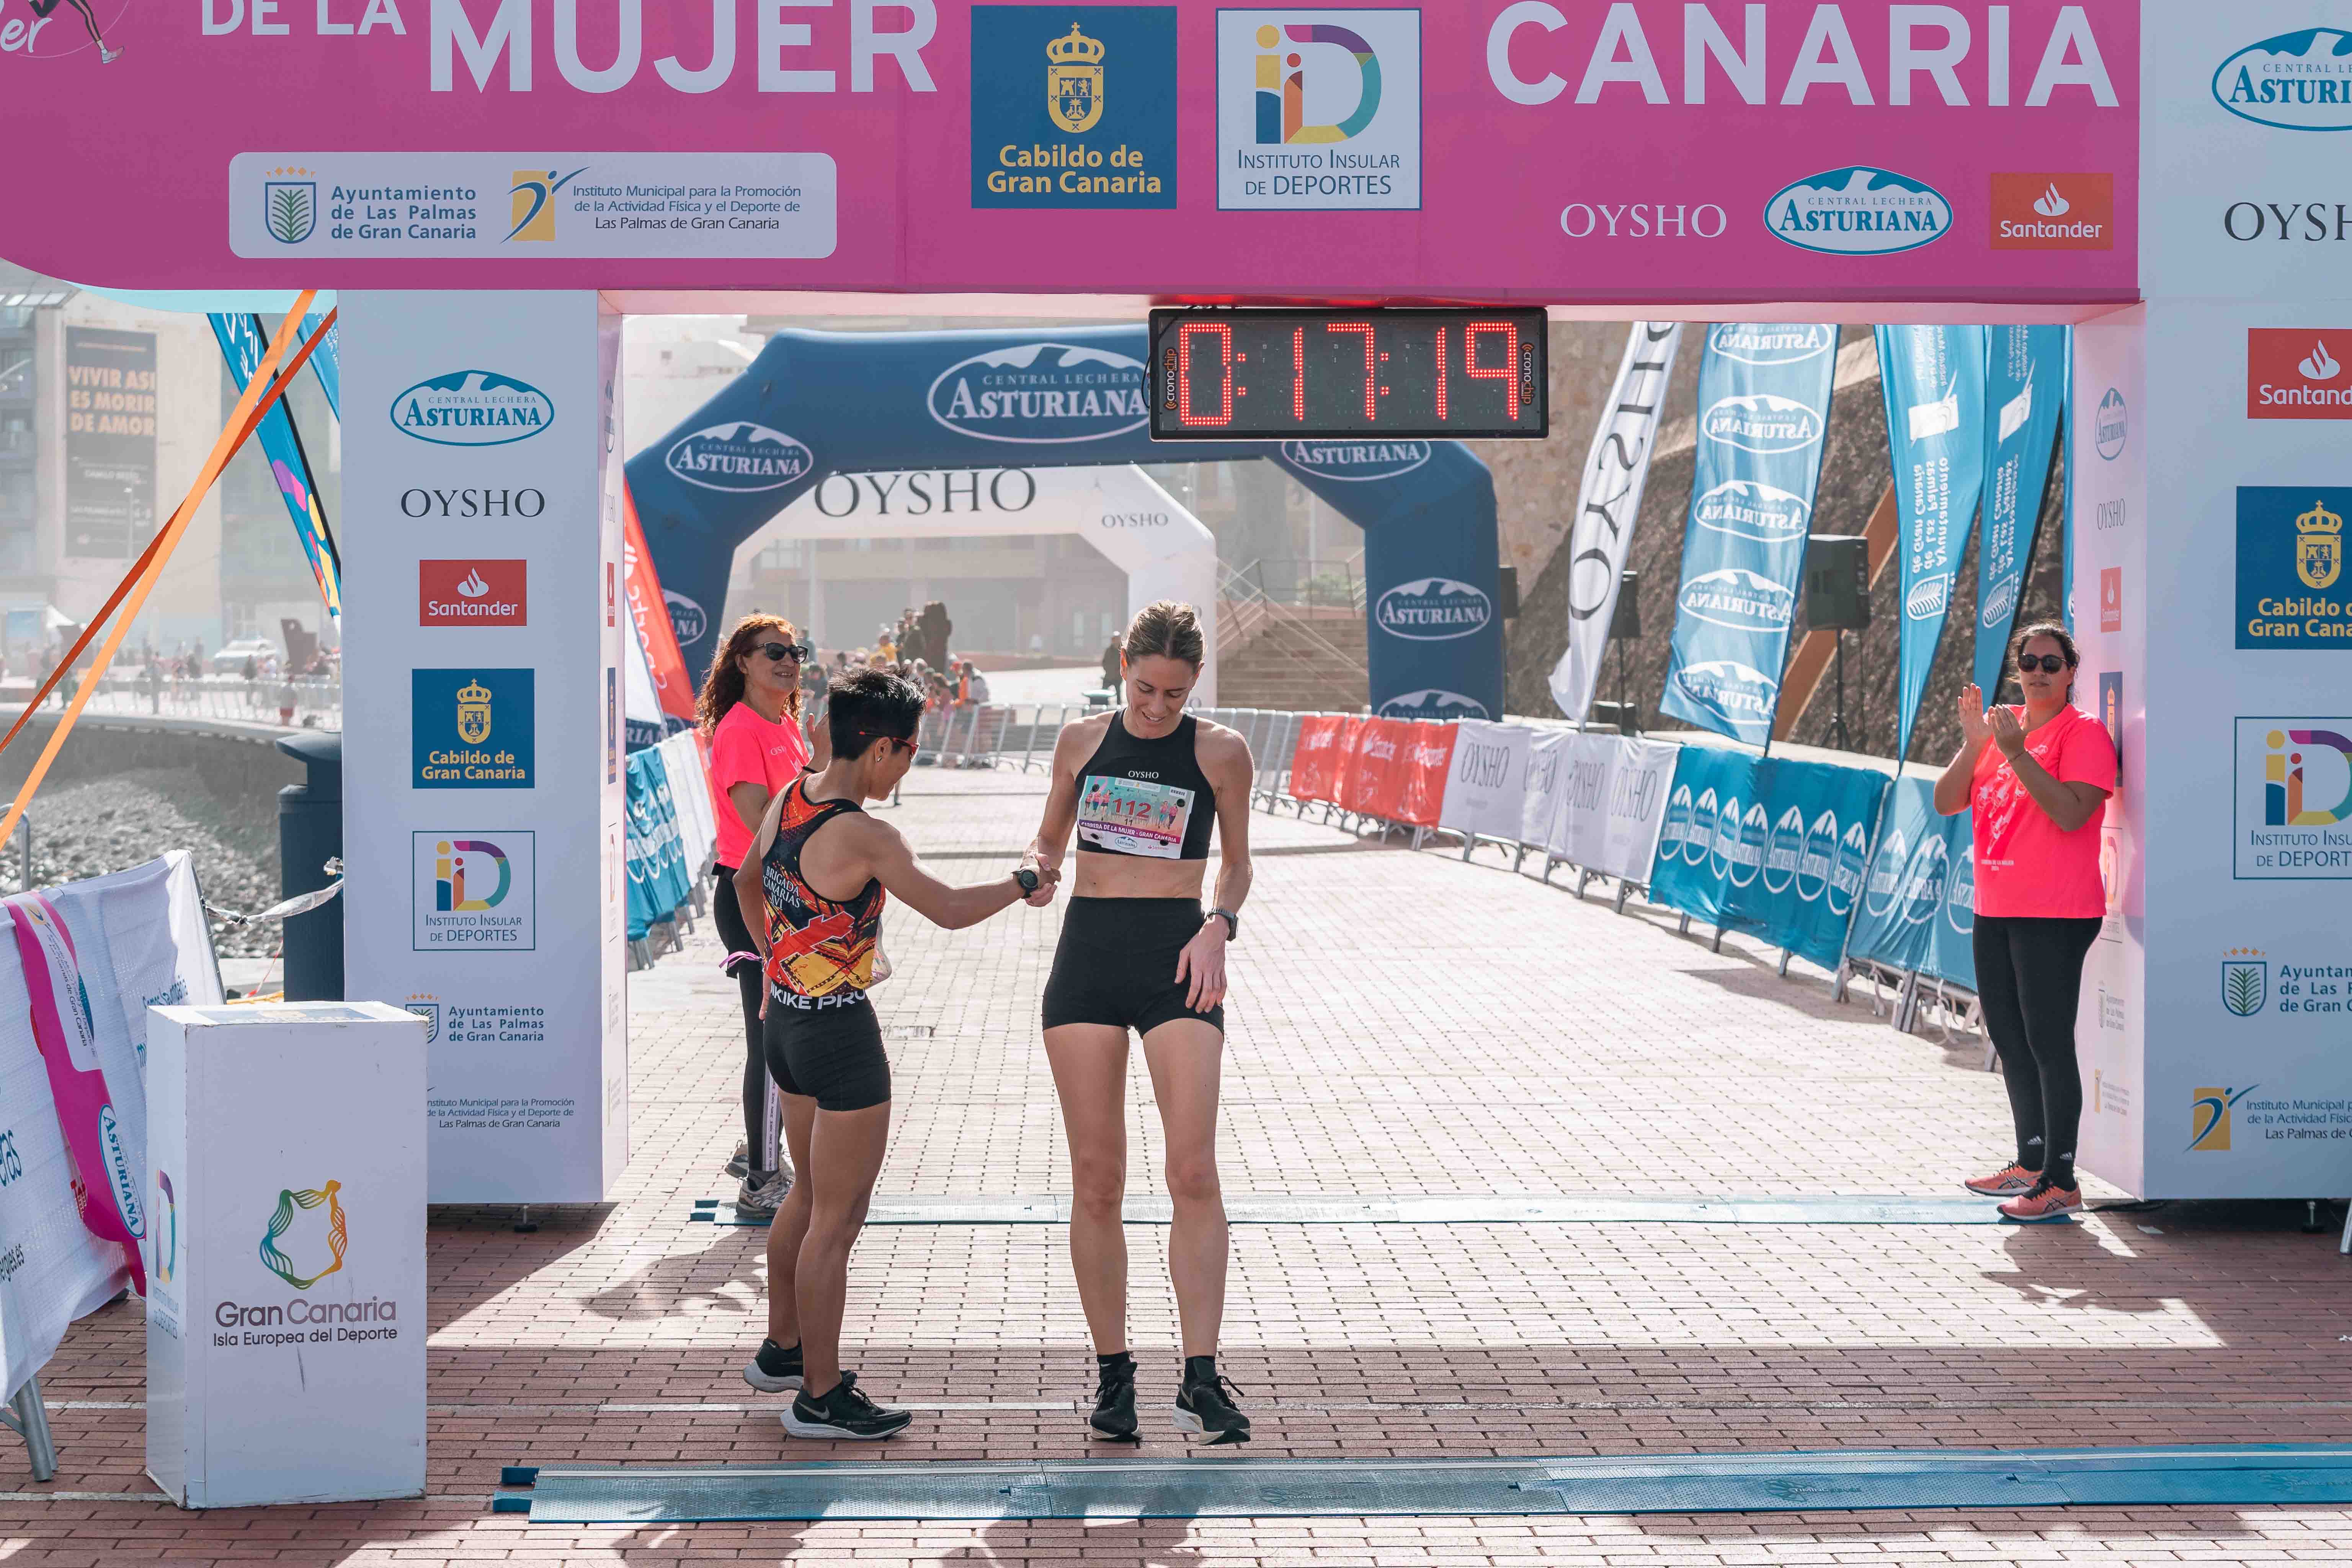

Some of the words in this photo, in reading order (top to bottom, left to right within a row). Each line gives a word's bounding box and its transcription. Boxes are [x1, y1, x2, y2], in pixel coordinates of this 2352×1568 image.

[202, 0, 289, 35] DE
[317, 0, 407, 35] LA
[430, 0, 937, 93] MUJER
[1487, 1, 2119, 107] CANARIA
[2263, 64, 2331, 72] CENTRAL
[1000, 144, 1102, 167] Cabildo
[1110, 145, 1143, 167] de
[1239, 150, 1322, 168] INSTITUTO
[1331, 150, 1399, 168] INSULAR
[988, 171, 1051, 193] Gran
[1060, 171, 1161, 193] Canaria
[1274, 175, 1391, 194] DEPORTES
[331, 185, 475, 204] Ayuntamiento
[574, 186, 622, 196] Instituto
[627, 186, 684, 199] Municipal
[689, 188, 716, 198] para
[721, 186, 730, 196] la
[736, 186, 800, 196] Promoción
[1873, 196, 1931, 205] LECHERA
[332, 204, 354, 219] de
[368, 205, 396, 219] Las
[410, 204, 476, 219] Palmas
[575, 201, 590, 211] de
[594, 201, 604, 211] la
[608, 201, 664, 211] Actividad
[669, 200, 701, 211] Física
[704, 204, 712, 214] y
[716, 201, 726, 211] el
[731, 201, 780, 214] Deporte
[785, 201, 800, 211] de
[1779, 198, 1938, 233] ASTURIANA
[596, 217, 616, 229] Las
[621, 217, 666, 229] Palmas
[671, 217, 687, 228] de
[691, 217, 724, 229] Gran
[729, 217, 779, 229] Canaria
[1561, 204, 1726, 237] OYSHO
[2001, 220, 2102, 237] Santander
[332, 224, 353, 238] de
[359, 224, 401, 238] Gran
[408, 224, 475, 238] Canaria
[68, 366, 121, 389] VIVIR
[982, 374, 1049, 385] CENTRAL
[1065, 372, 1140, 384] LECHERA
[1164, 348, 1176, 401] cronochip
[1180, 322, 1518, 426] 0:17:19
[1522, 352, 1534, 404] cronochip
[70, 390, 90, 409] ES
[94, 394, 155, 412] MORIR
[946, 378, 1148, 419] ASTURIANA
[403, 399, 542, 426] ASTURIANA
[70, 413, 95, 432] DE
[98, 417, 155, 436] AMOR
[699, 443, 748, 453] CENTRAL
[1294, 441, 1421, 464] ASTURIANA
[676, 444, 801, 475] ASTURIANA
[814, 469, 1036, 518] OYSHO
[401, 489, 544, 517] OYSHO
[1101, 513, 1168, 528] OYSHO
[2097, 498, 2125, 530] OYSHO
[429, 601, 518, 616] Santander
[1382, 600, 1484, 624] ASTURIANA
[2258, 598, 2340, 616] Cabildo
[2249, 619, 2299, 637] Gran
[429, 750, 490, 765] Cabildo
[495, 750, 514, 763] de
[422, 765, 460, 779] Gran
[465, 766, 525, 779] Canaria
[1128, 770, 1159, 779] OYSHO
[1113, 798, 1152, 818] 112
[1081, 822, 1102, 830] CARRERA
[1118, 827, 1135, 835] MUJER
[1154, 833, 1176, 843] CANARIA
[2251, 830, 2318, 845] INSTITUTO
[2279, 851, 2352, 866] DEPORT
[766, 866, 799, 897] BRIGADA
[771, 892, 782, 908] XVI
[426, 915, 476, 926] INSTITUTO
[481, 914, 521, 925] INSULAR
[447, 929, 517, 941] DEPORTES
[2280, 980, 2299, 995] de
[2311, 982, 2337, 995] Las
[449, 1006, 544, 1020] Ayuntamiento
[2280, 998, 2298, 1012] de
[2304, 999, 2340, 1012] Gran
[449, 1018, 464, 1028] de
[472, 1019, 492, 1028] Las
[500, 1018, 544, 1028] Palmas
[449, 1031, 463, 1041] de
[467, 1032, 495, 1041] Gran
[500, 1031, 543, 1041] Canaria
[427, 1098, 457, 1107] nstituto
[460, 1099, 499, 1108] Municipal
[500, 1099, 519, 1108] para
[2247, 1101, 2289, 1110] Instituto
[2293, 1099, 2345, 1113] Municipal
[502, 1119, 524, 1127] Gran
[527, 1119, 560, 1127] Canaria
[510, 1111, 516, 1120] y
[528, 1109, 560, 1119] Deporte
[2248, 1114, 2261, 1124] de
[2265, 1114, 2273, 1124] la
[2277, 1114, 2326, 1123] Actividad
[2266, 1129, 2284, 1139] Las
[2288, 1129, 2328, 1139] Palmas
[2331, 1128, 2346, 1138] de
[103, 1114, 139, 1227] ASTURIANA
[214, 1300, 284, 1328] Gran
[286, 1294, 397, 1325] Canaria
[213, 1332, 238, 1347] Isla
[243, 1330, 305, 1347] Europea
[309, 1328, 332, 1342] del
[337, 1326, 398, 1343] Deporte
